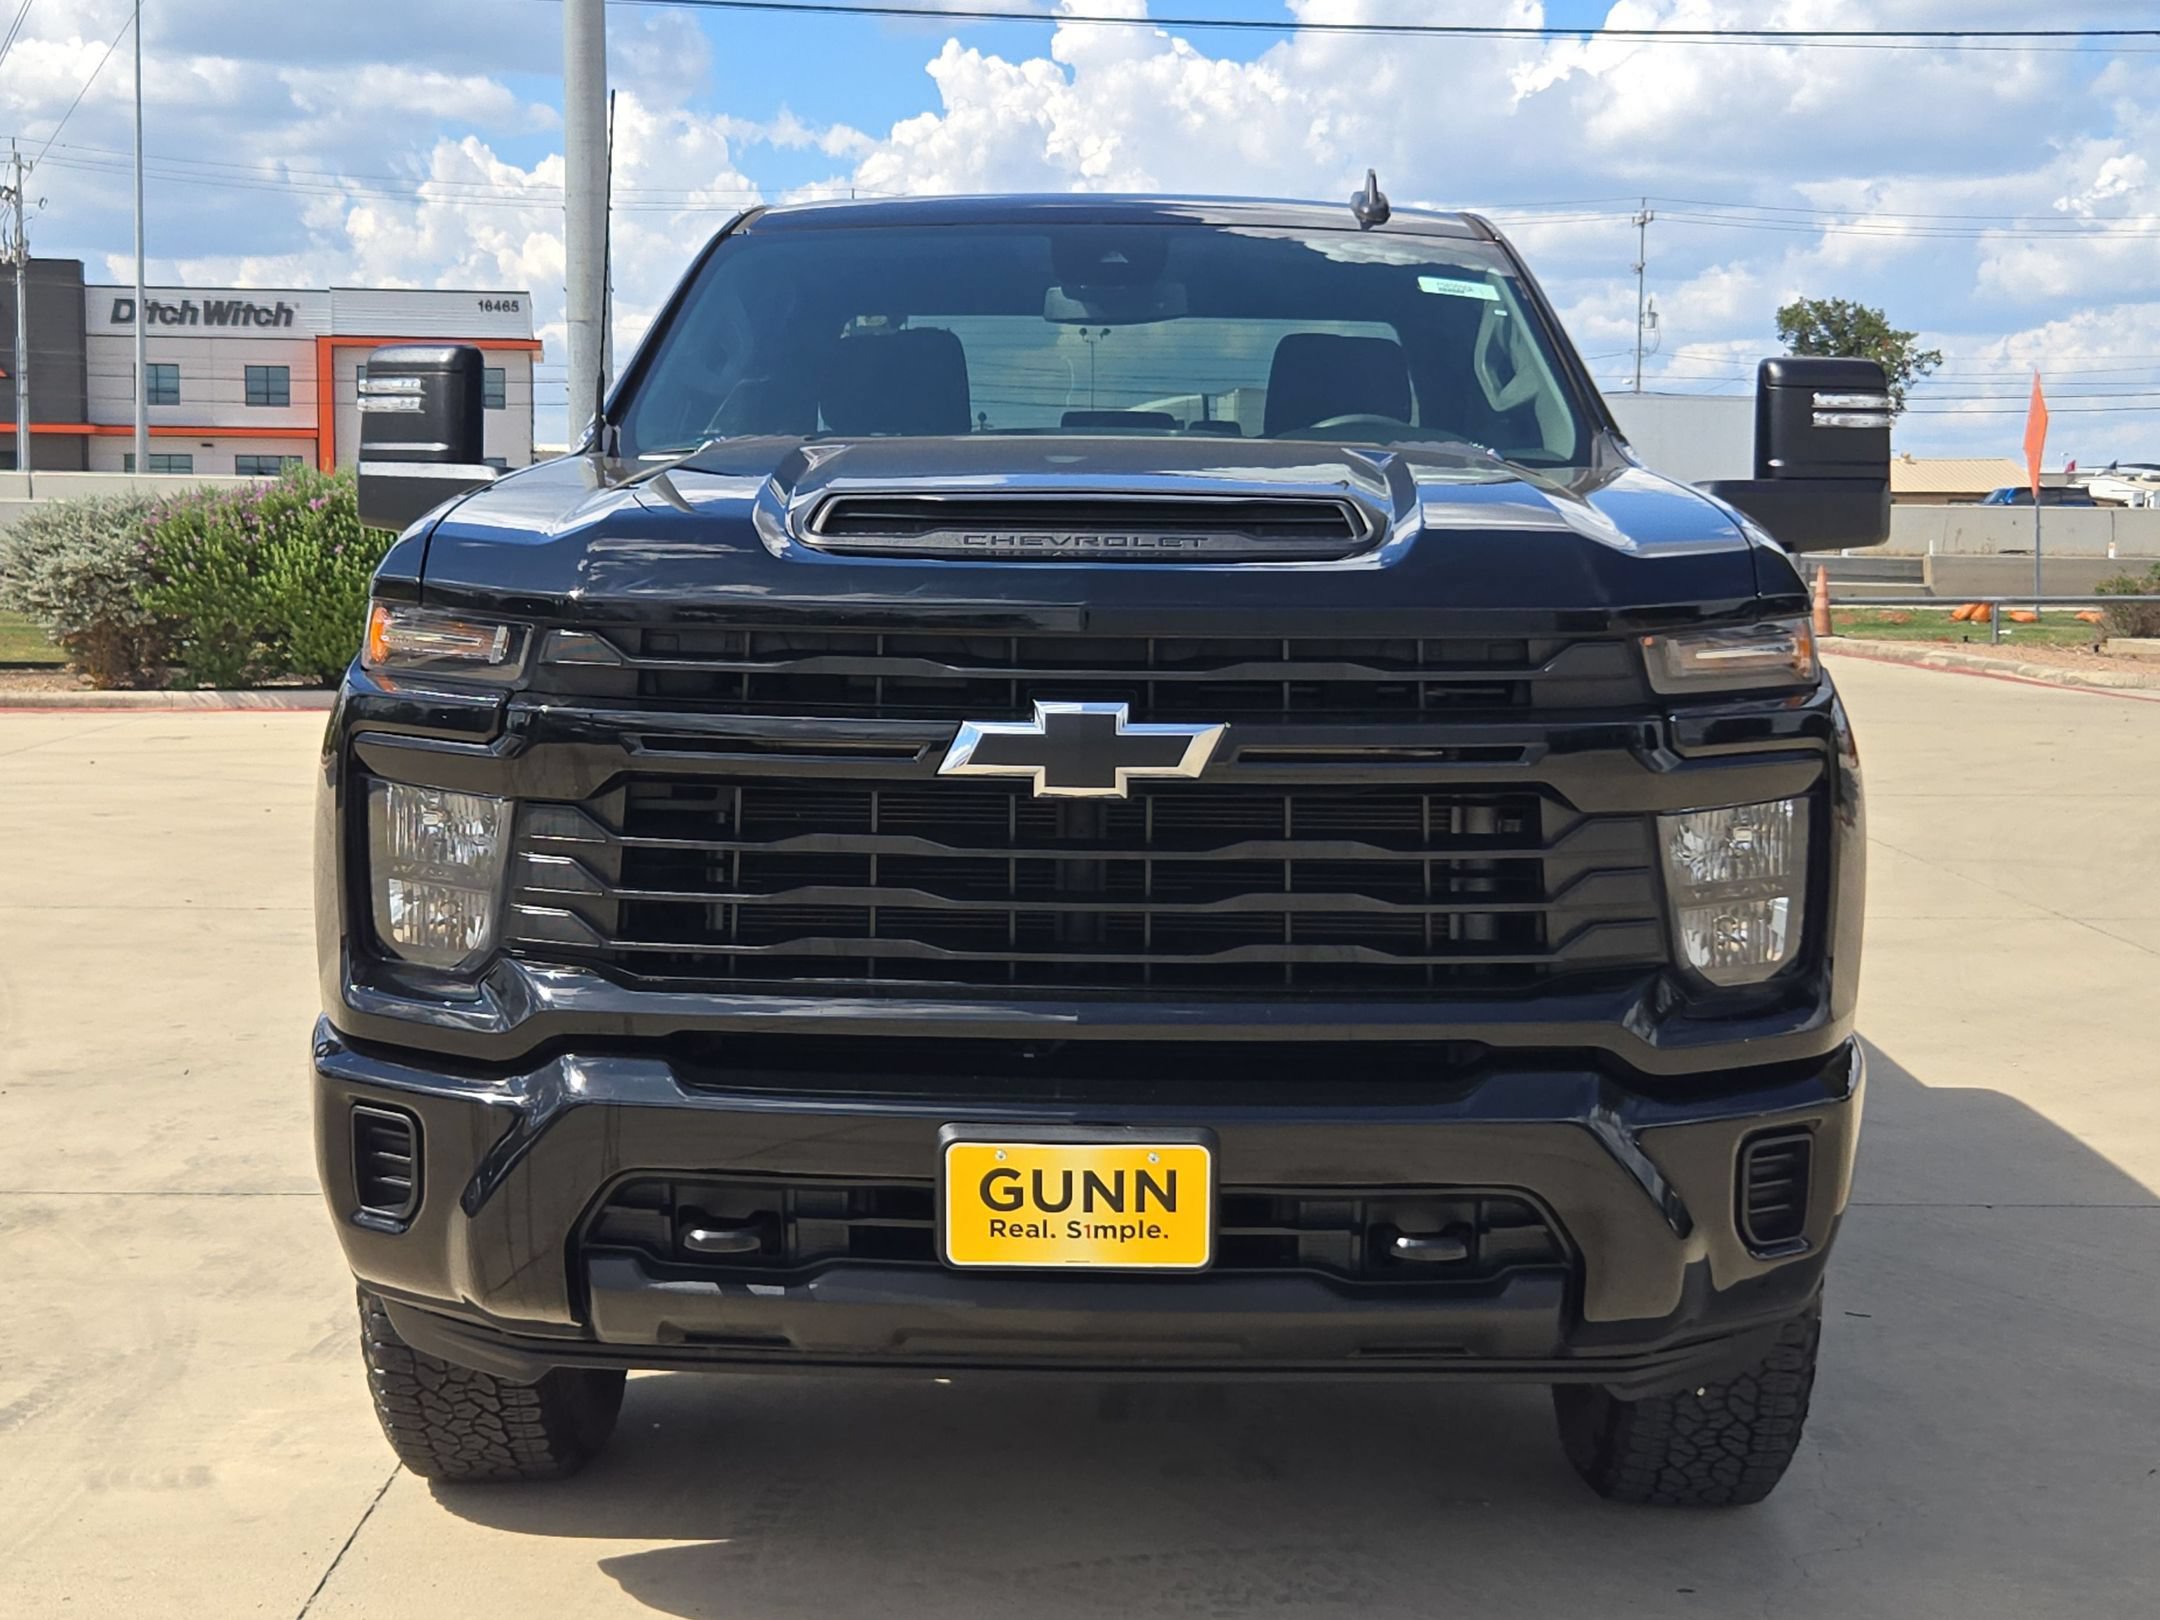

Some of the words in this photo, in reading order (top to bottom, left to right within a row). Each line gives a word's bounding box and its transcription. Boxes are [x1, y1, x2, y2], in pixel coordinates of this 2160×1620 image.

[203, 300, 295, 327] Witch
[478, 299, 519, 313] 16465
[963, 535, 1208, 548] CHEVROLET
[979, 1167, 1177, 1213] GUNN
[989, 1218, 1056, 1239] Real.
